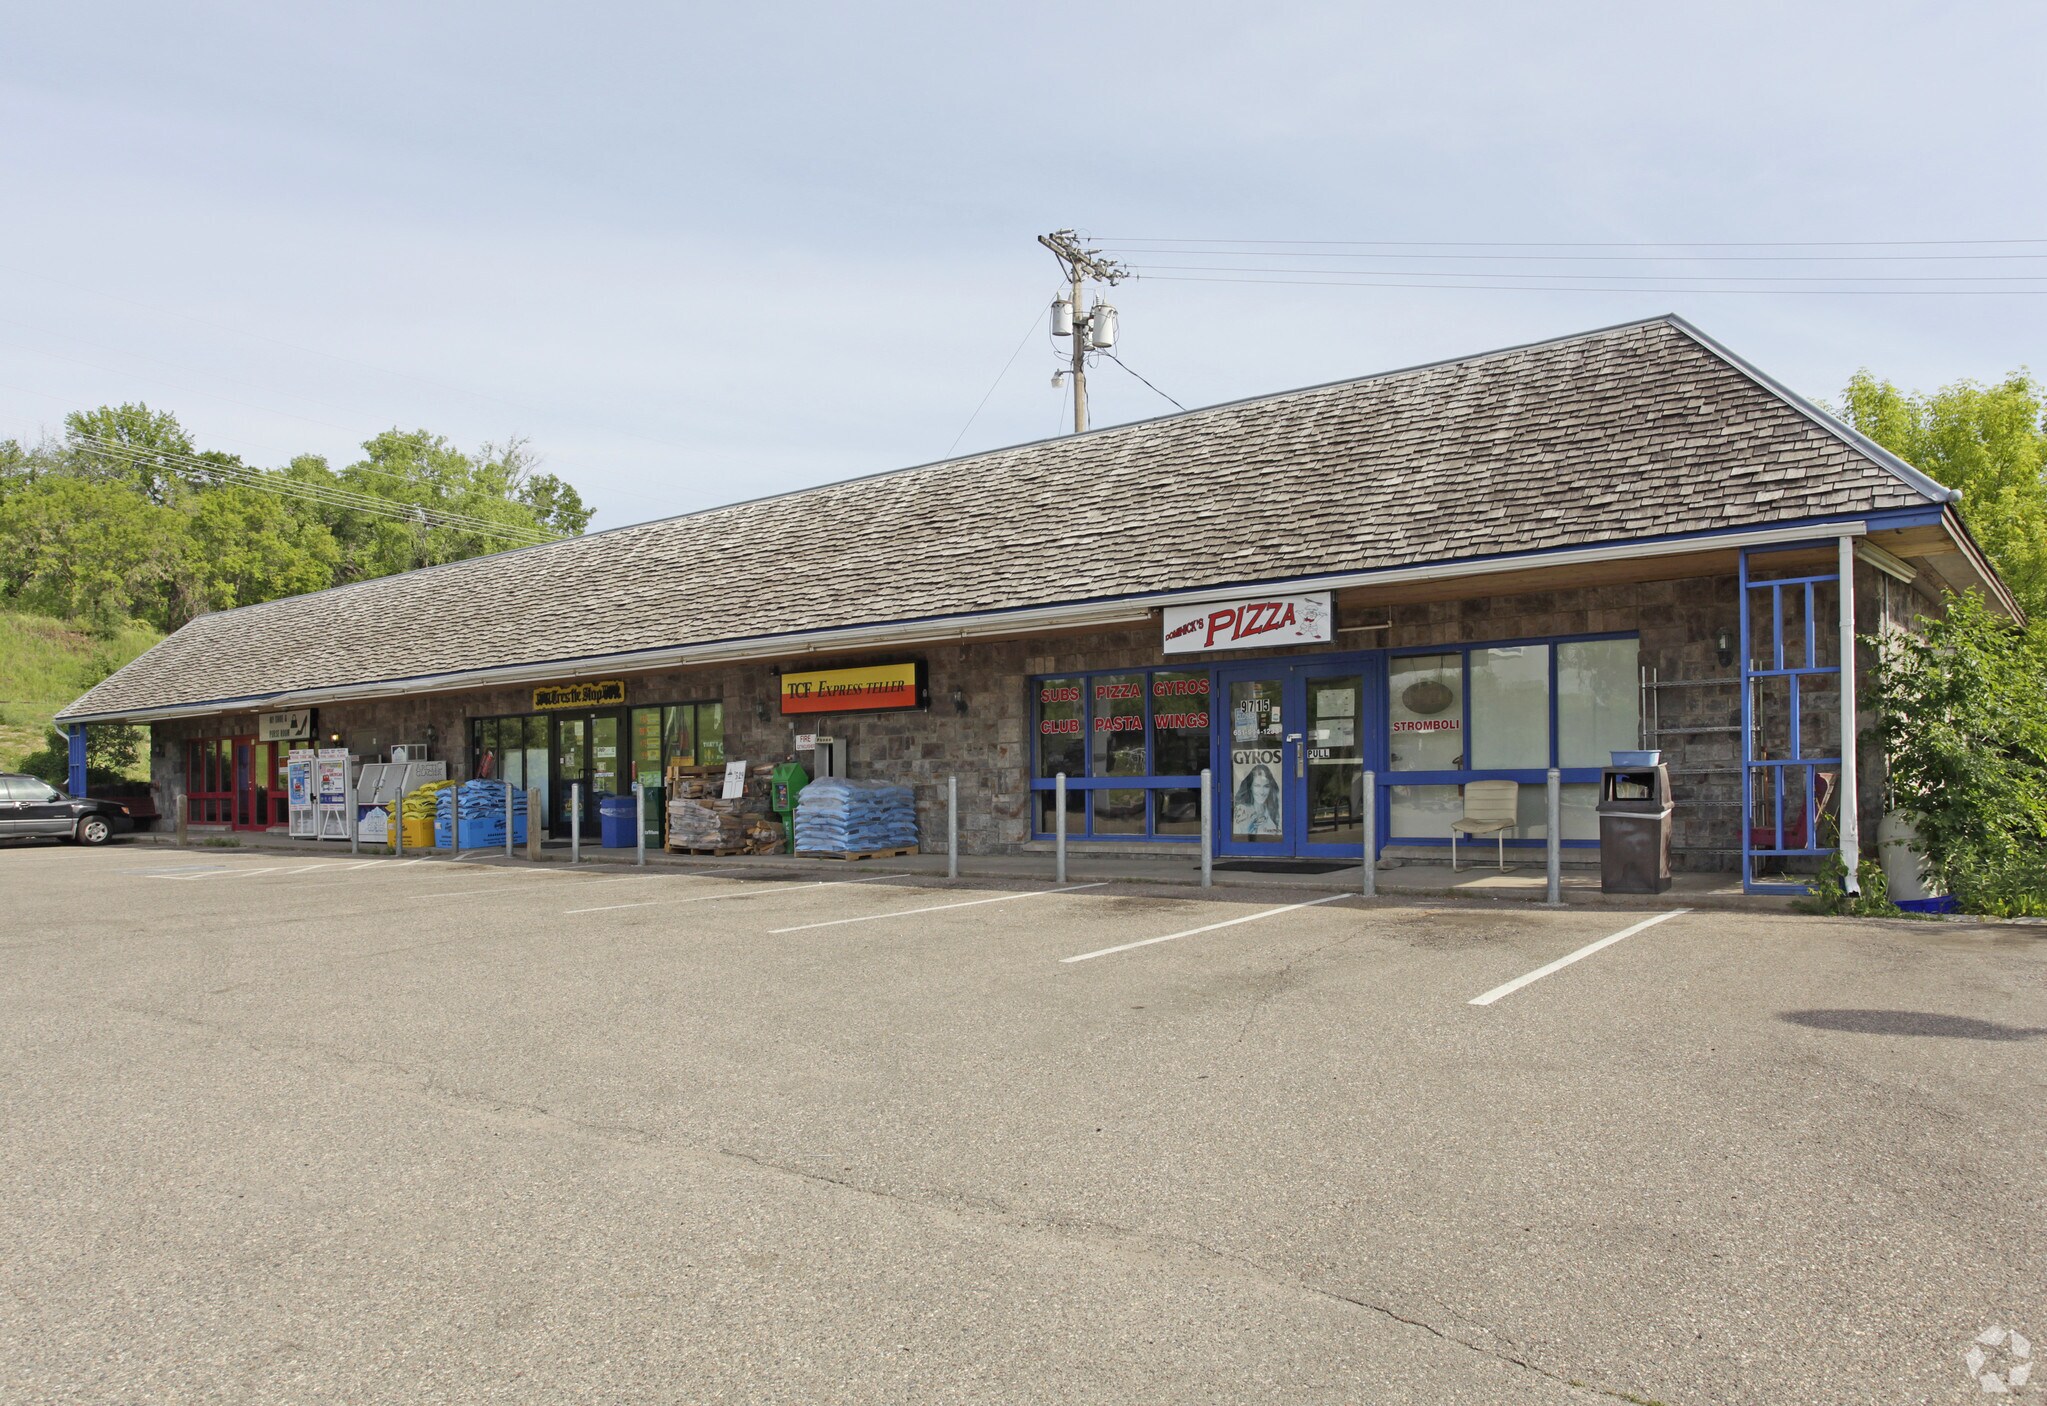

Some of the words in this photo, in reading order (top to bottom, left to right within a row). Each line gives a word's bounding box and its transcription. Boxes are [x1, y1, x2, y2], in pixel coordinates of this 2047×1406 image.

[1165, 617, 1204, 641] DOMINICK'S
[1204, 602, 1296, 648] PIZZA
[583, 687, 602, 703] Stop
[788, 682, 812, 699] TCF
[867, 680, 905, 694] TELLER
[1040, 687, 1080, 703] SUBS
[1095, 683, 1141, 700] PIZZA
[1153, 679, 1210, 697] GYROS
[1241, 699, 1270, 713] 9715
[1040, 718, 1080, 735] CLUB
[1094, 715, 1142, 732] PASTA
[1155, 712, 1209, 730] WINGS
[1393, 719, 1459, 732] STROMBOLI
[269, 729, 280, 738] PURSE
[280, 728, 290, 738] ROOM
[1233, 750, 1282, 765] GYROS
[1307, 749, 1329, 758] PULL
[416, 762, 443, 770] ARCTIC
